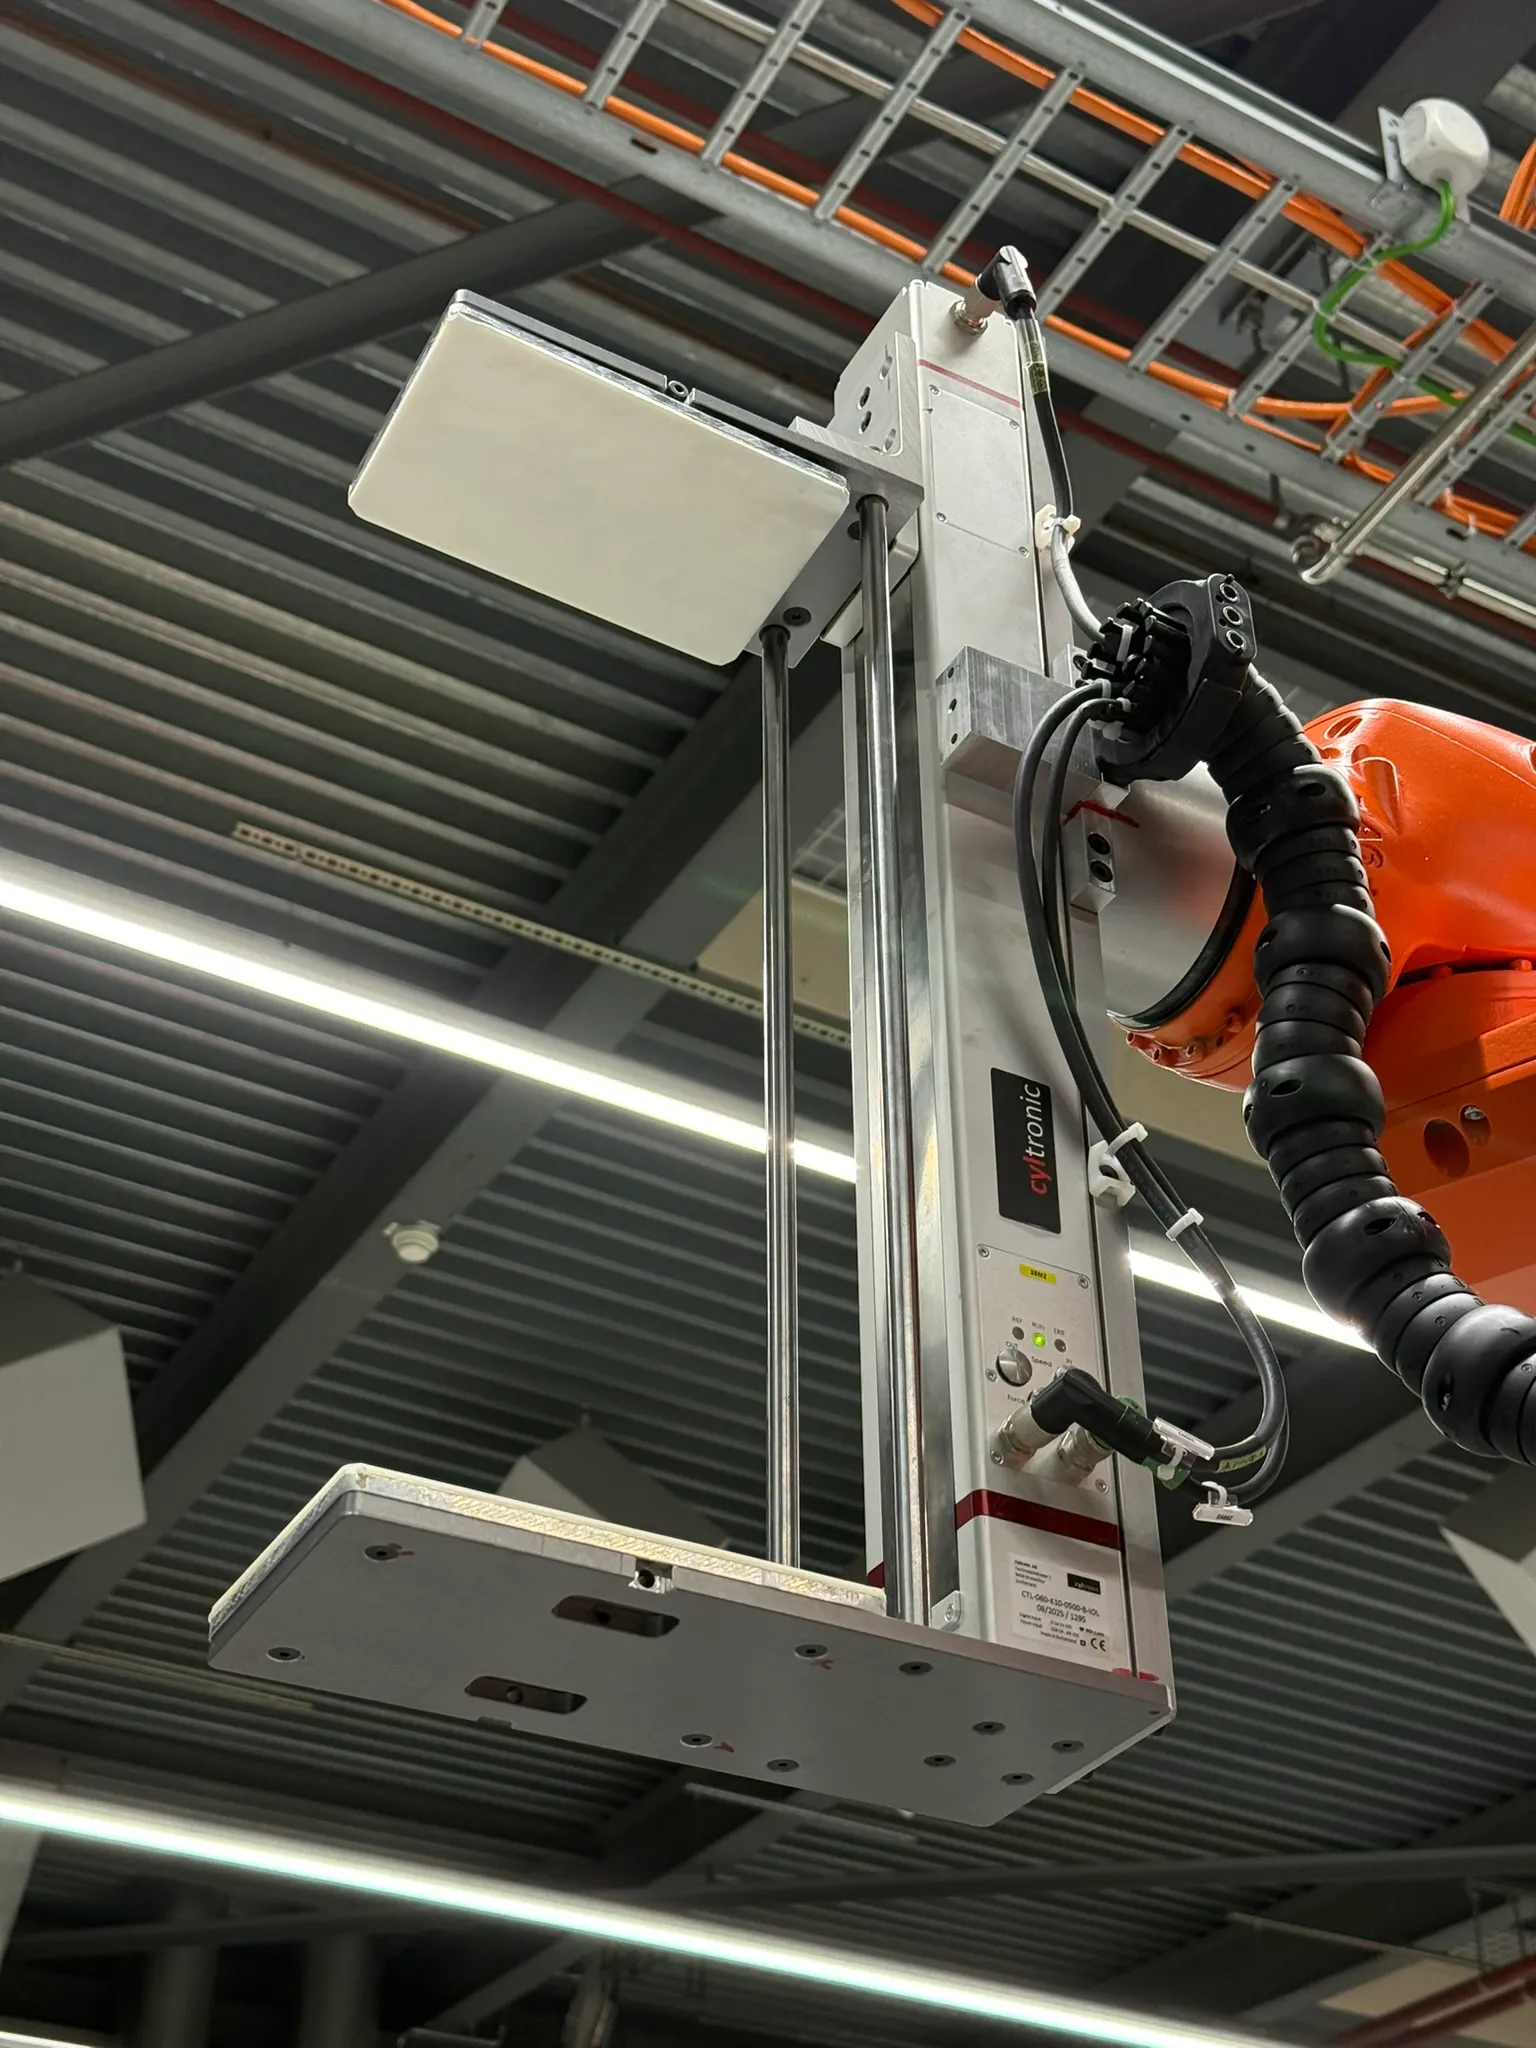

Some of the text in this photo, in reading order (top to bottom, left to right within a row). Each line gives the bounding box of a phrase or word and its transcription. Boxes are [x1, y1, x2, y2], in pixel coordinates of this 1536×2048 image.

[1019, 1084, 1053, 1195] cyltronic
[1031, 1321, 1045, 1331] RUN
[1005, 1340, 1019, 1350] OUT
[1031, 1356, 1053, 1368] Speed
[1007, 1394, 1026, 1405] Force
[1036, 1604, 1064, 1618] 06/2025
